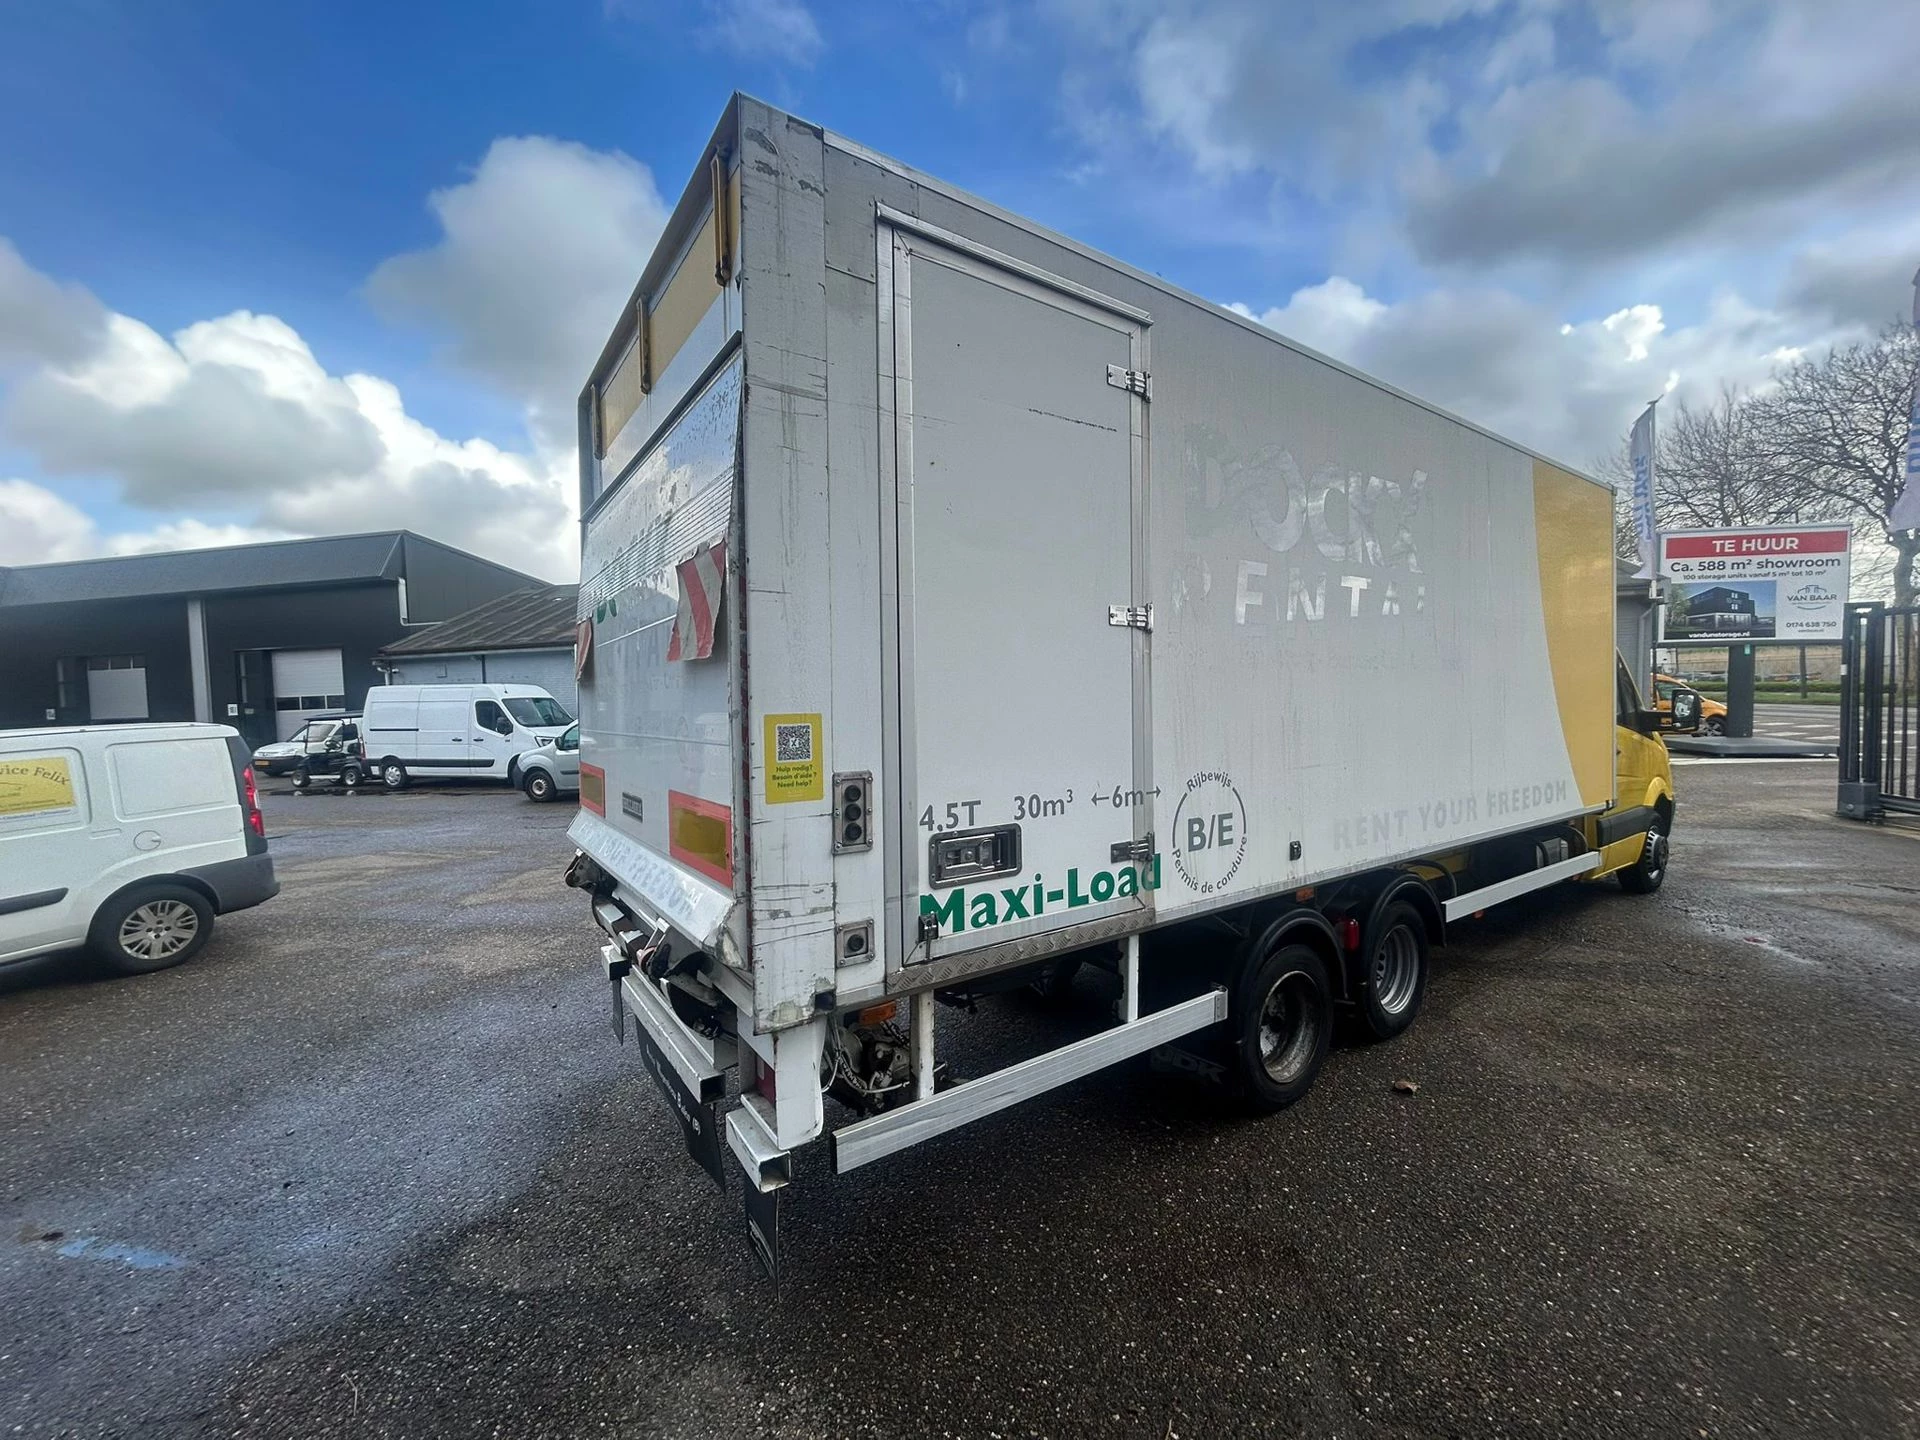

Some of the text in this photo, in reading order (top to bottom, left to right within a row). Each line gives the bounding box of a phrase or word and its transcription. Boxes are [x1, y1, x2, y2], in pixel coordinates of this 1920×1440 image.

[1712, 537, 1799, 553] TE HUUR
[1670, 562, 1693, 572] Ca.
[1698, 560, 1726, 572] 588
[1757, 557, 1841, 569] showroom
[1697, 573, 1727, 581] storage
[1810, 593, 1837, 601] BAAR
[34, 766, 70, 785] Felix
[776, 764, 813, 774] Hulp nodig?
[777, 779, 812, 788] Need help?
[1187, 771, 1232, 793] Rijbewijs
[919, 799, 981, 832] 4.5T
[1333, 780, 1567, 850] RENT YOUR FREEDOM
[1188, 812, 1234, 852] B/E
[1172, 836, 1247, 894] Permis de conduire
[920, 853, 1161, 933] Maxi-Load
